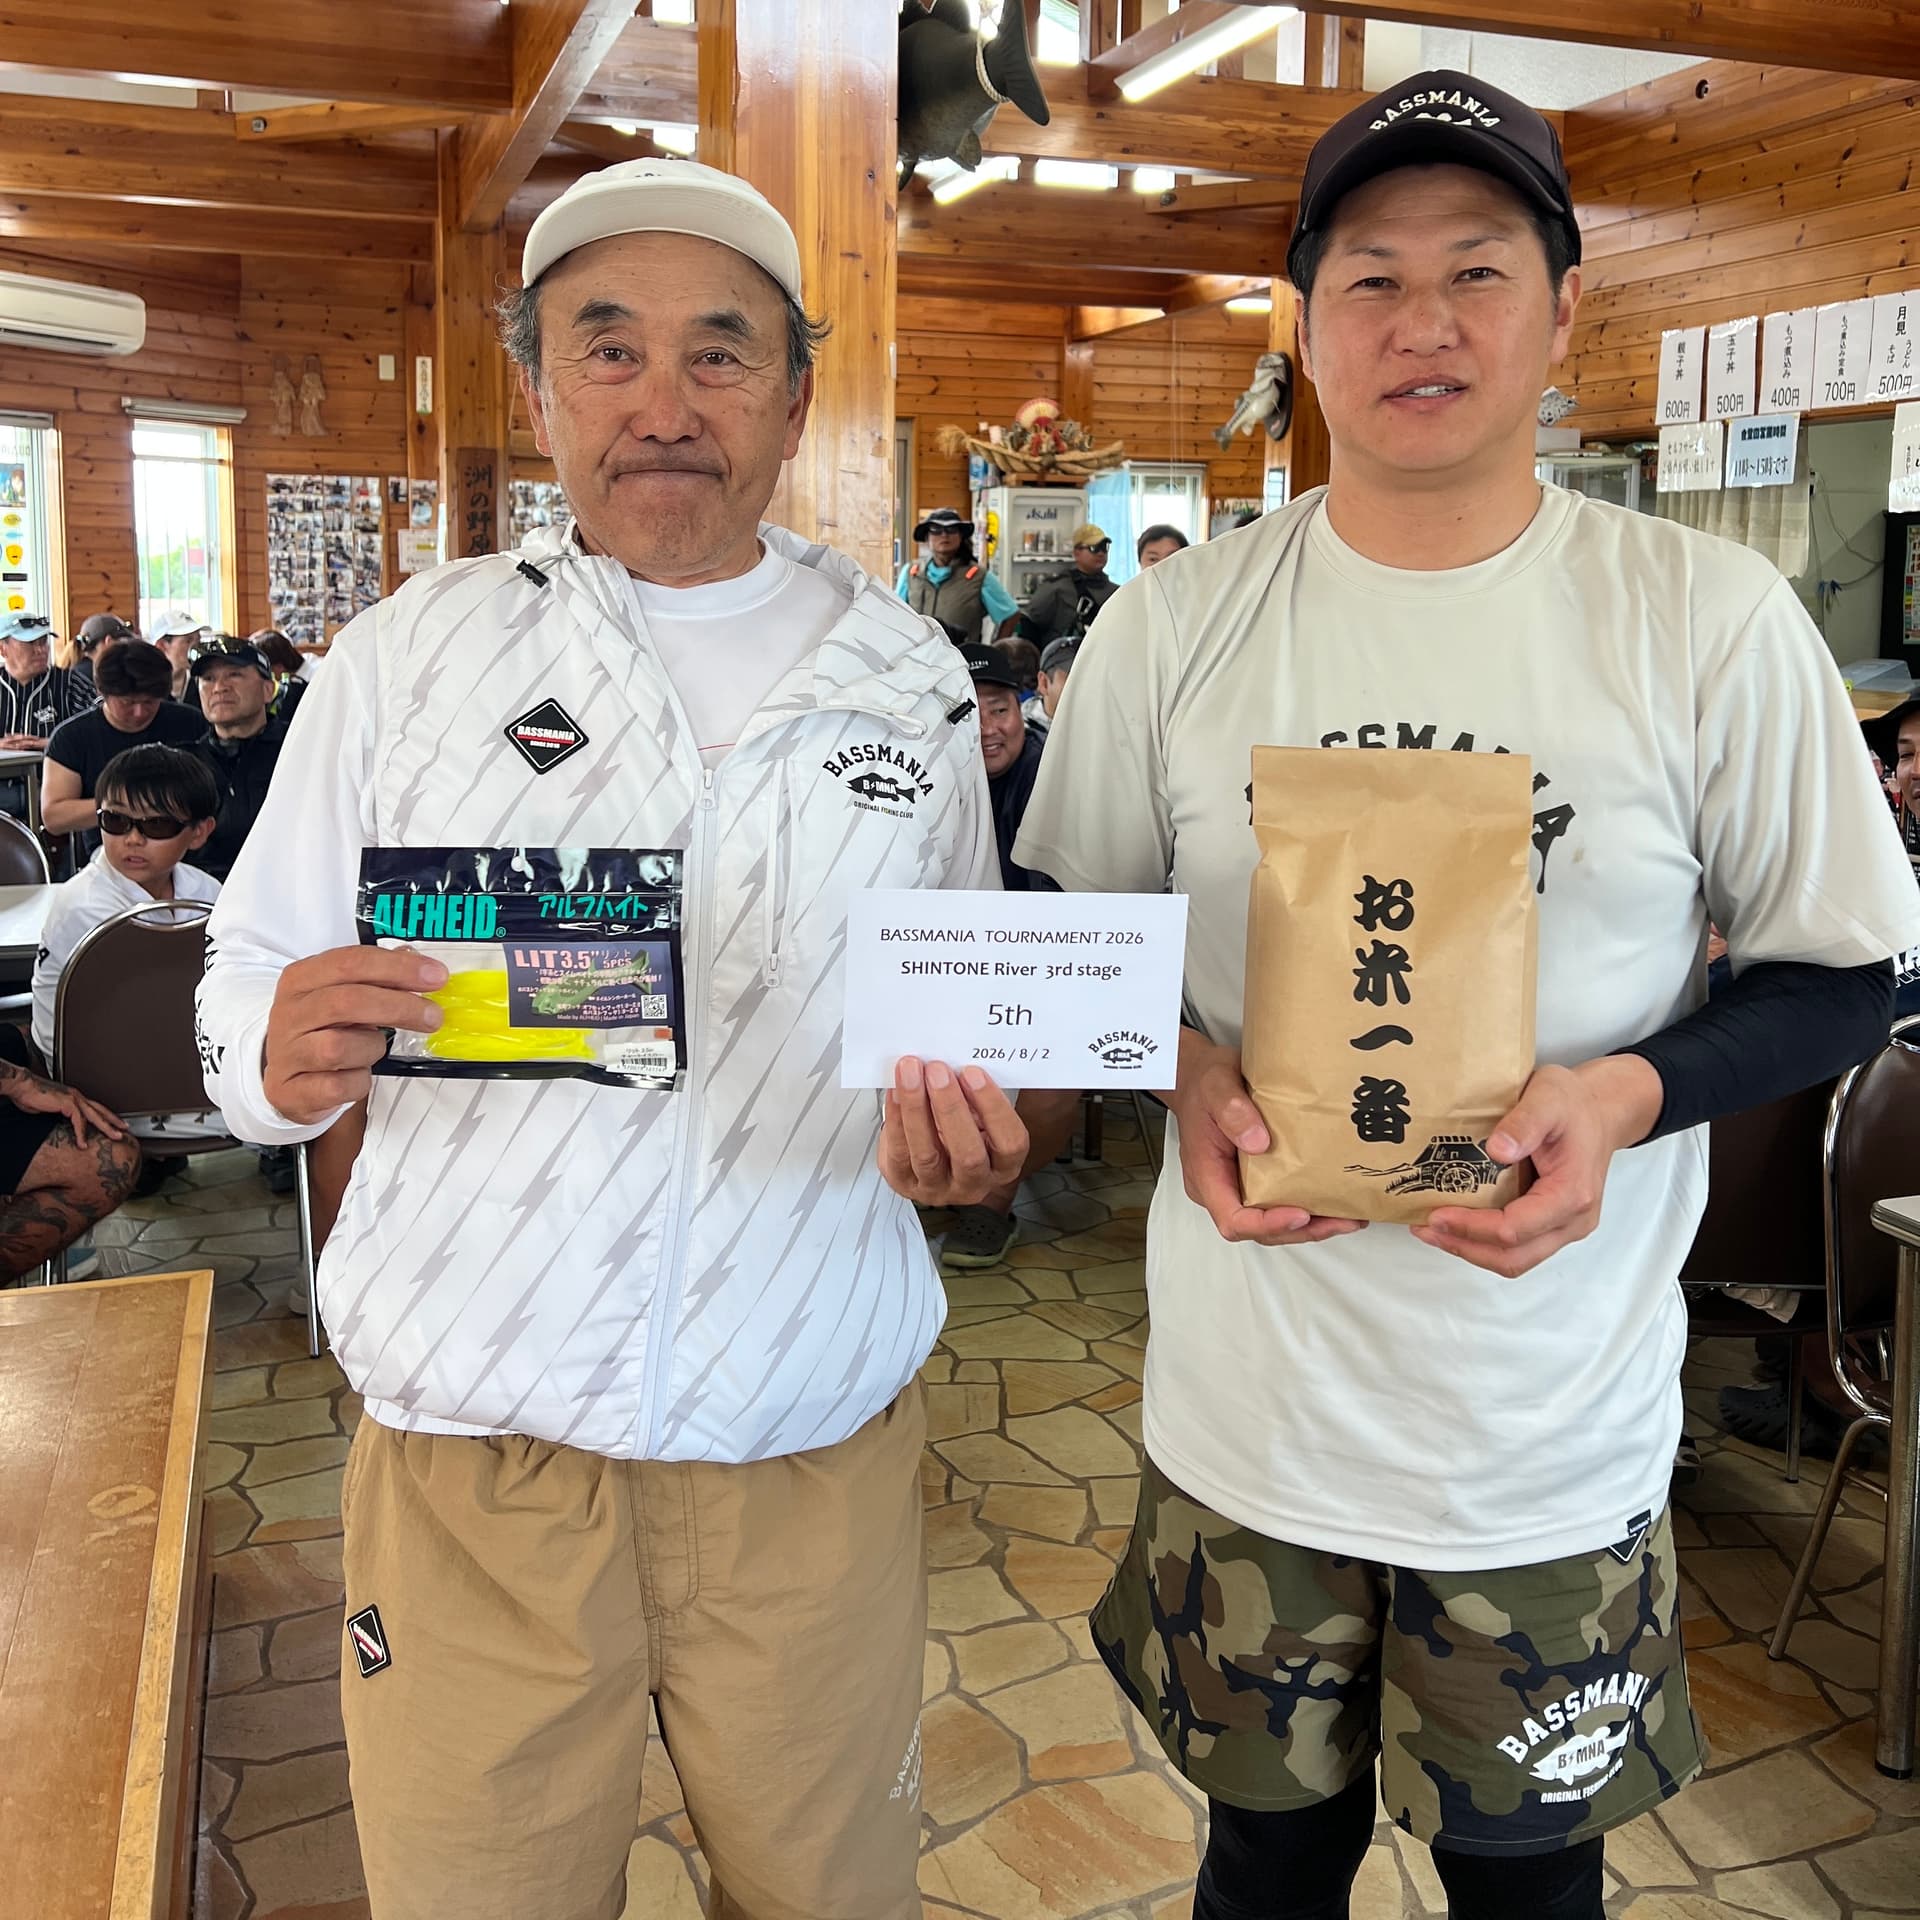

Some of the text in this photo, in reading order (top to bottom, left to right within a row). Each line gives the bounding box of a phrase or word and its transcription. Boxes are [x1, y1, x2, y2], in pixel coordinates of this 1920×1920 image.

[1369, 90, 1501, 131] BASSMANIA
[1895, 305, 1907, 337] 月見
[1781, 324, 1794, 380] もつ煮込み
[1886, 344, 1897, 364] そば
[1902, 339, 1912, 369] うどん
[1770, 386, 1800, 408] 400円
[1824, 380, 1856, 402] 700円
[1665, 399, 1690, 419] 600円
[1716, 393, 1744, 414] 500円
[516, 724, 576, 742] BASSMANIA
[822, 743, 934, 796] BASSMANIA
[853, 800, 880, 813] ORIGINAL
[899, 811, 914, 819] CLUB
[538, 894, 649, 920] アルフハイト
[880, 928, 1144, 945] BASSMANIA TOURNAMENT 2026
[513, 949, 558, 968] LIT
[603, 957, 633, 968] 5PCS
[900, 961, 1122, 981] SHINTONE River 3rd stage
[987, 1003, 1033, 1026] 5th
[1349, 875, 1415, 1144] お米一番
[1088, 1030, 1158, 1054] BASSMANIA
[1496, 1671, 1651, 1764] BASSMANI
[1540, 1788, 1582, 1804] ORIGINAL
